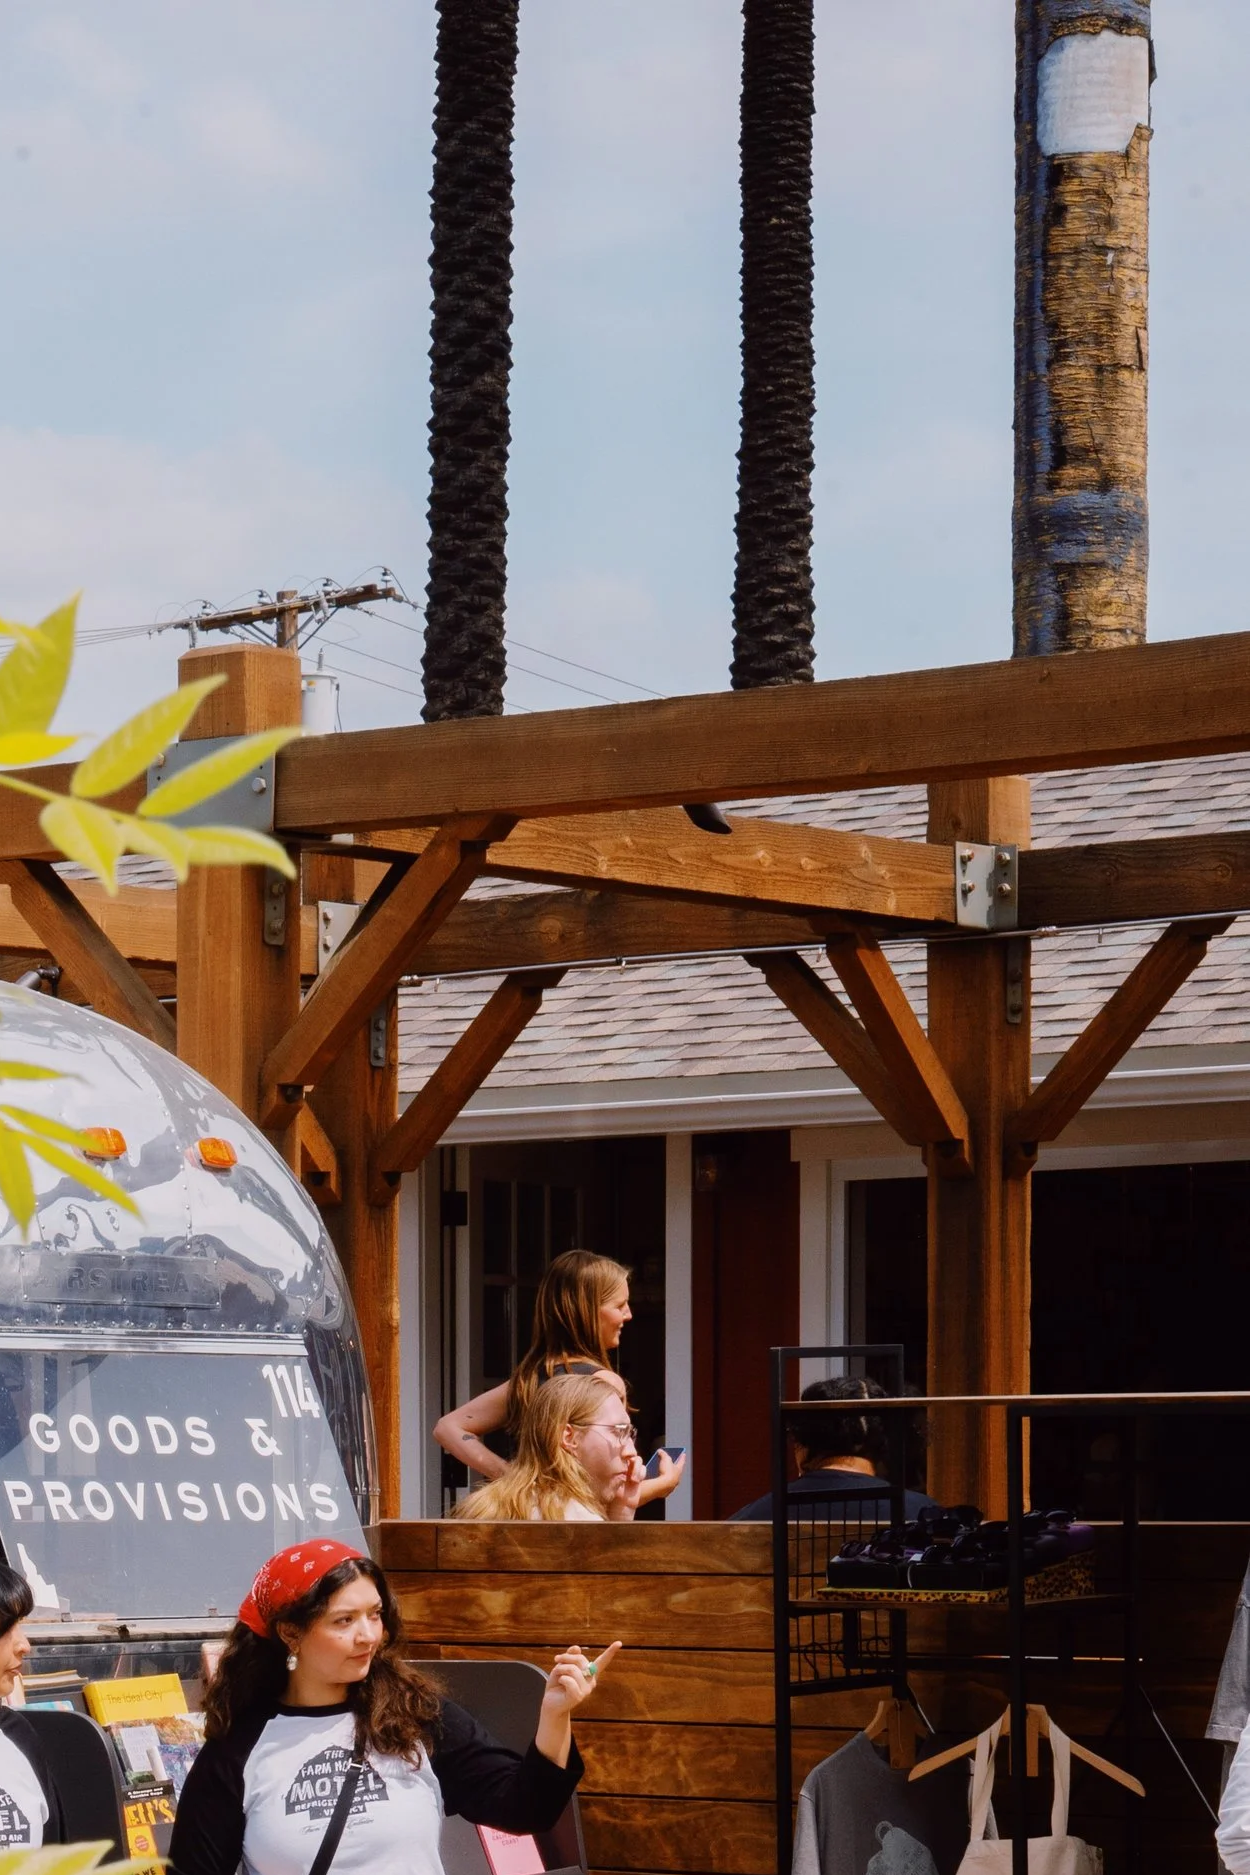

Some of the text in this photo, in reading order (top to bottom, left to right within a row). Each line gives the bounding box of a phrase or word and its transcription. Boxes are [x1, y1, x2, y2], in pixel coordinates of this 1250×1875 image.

[261, 1363, 320, 1419] 114
[29, 1412, 283, 1457] GOODS &
[3, 1480, 339, 1522] PROVISIONS
[106, 1690, 164, 1705] The Ideal City
[324, 1750, 345, 1760] THE
[301, 1763, 332, 1778] FARM
[363, 1793, 379, 1801] AIR
